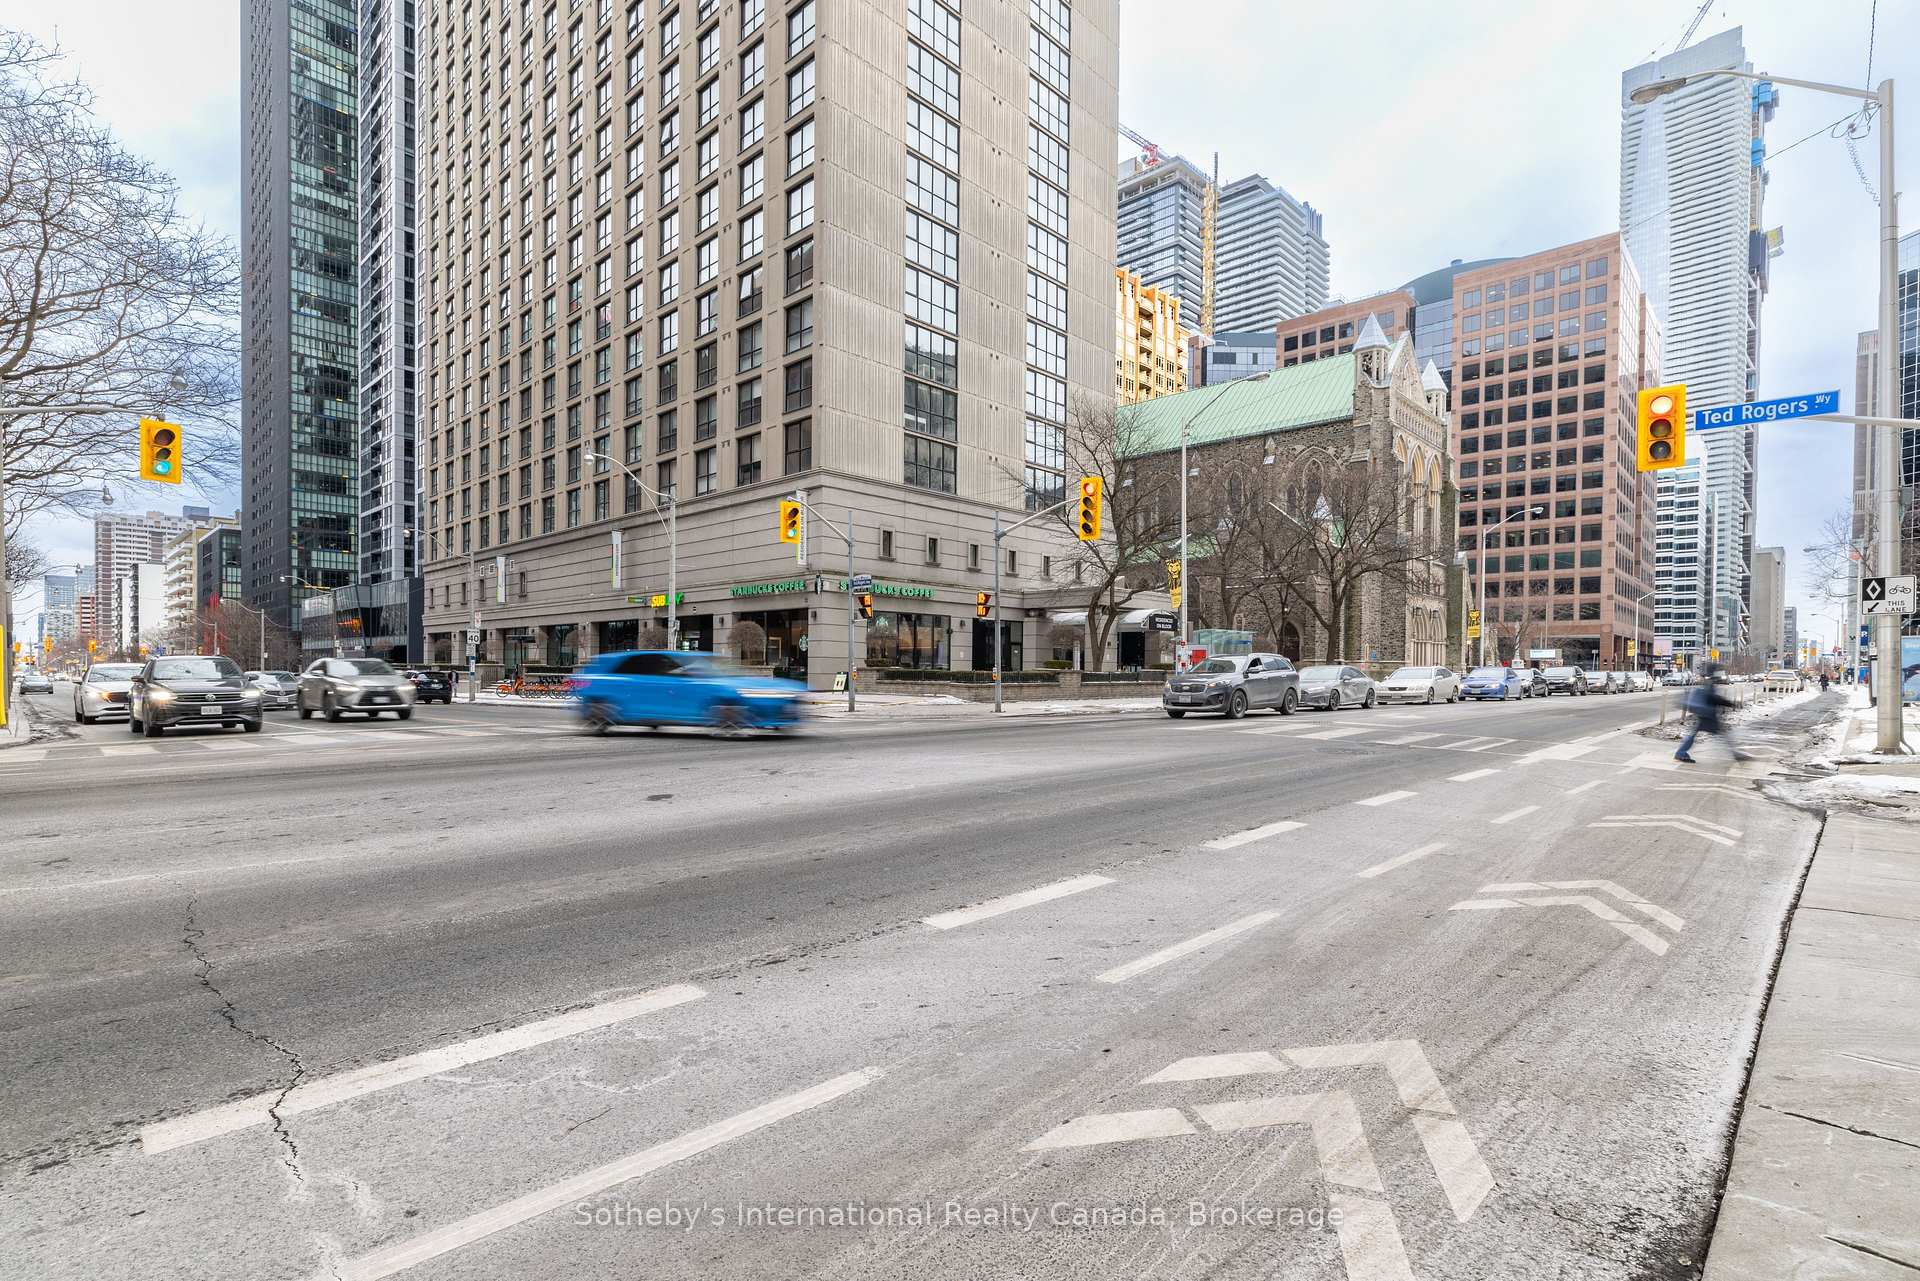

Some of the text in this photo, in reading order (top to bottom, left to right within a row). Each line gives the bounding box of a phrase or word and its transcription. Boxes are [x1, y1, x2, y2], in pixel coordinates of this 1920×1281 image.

[1701, 408, 1733, 425] Ted
[1742, 399, 1808, 420] Rogers
[773, 580, 805, 592] COFFEE
[651, 592, 685, 608] SUBY
[468, 634, 479, 643] 40
